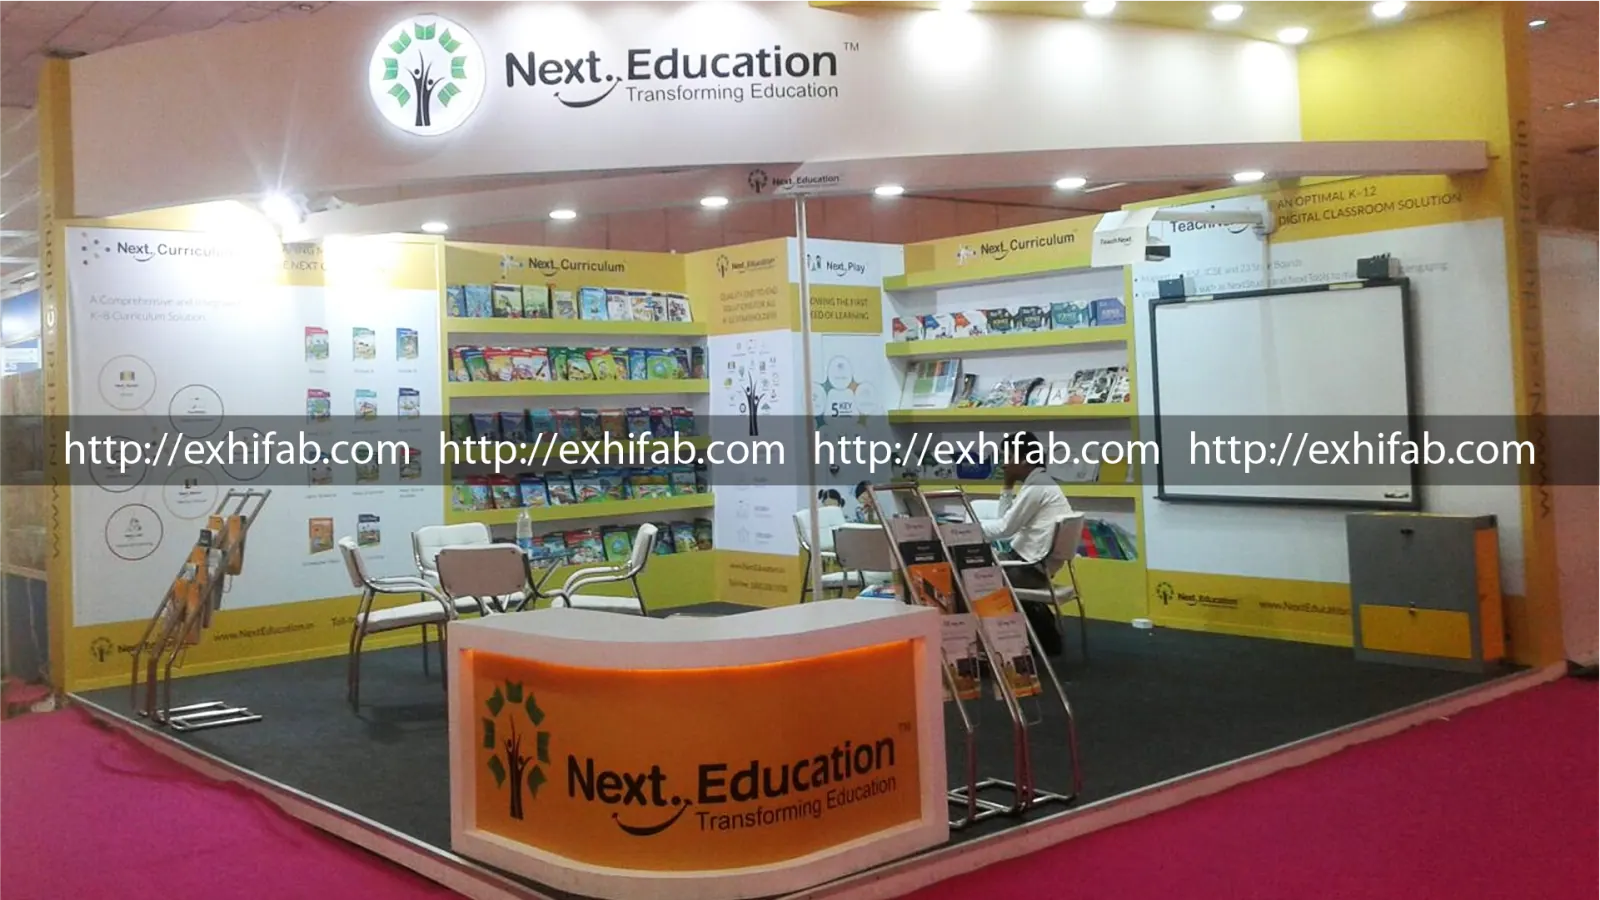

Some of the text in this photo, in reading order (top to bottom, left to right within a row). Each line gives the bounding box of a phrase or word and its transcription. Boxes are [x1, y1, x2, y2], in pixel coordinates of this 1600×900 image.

[627, 46, 838, 81] Education
[625, 81, 839, 104] Transforming Education
[1278, 192, 1463, 226] DIGITAL CLASSROOM SOLUTION
[1295, 192, 1345, 207] OPTIMAL
[1010, 233, 1075, 251] Curriculum
[561, 258, 625, 273] Curriculum
[699, 738, 895, 804] Education
[695, 775, 897, 832] Transforming Education
